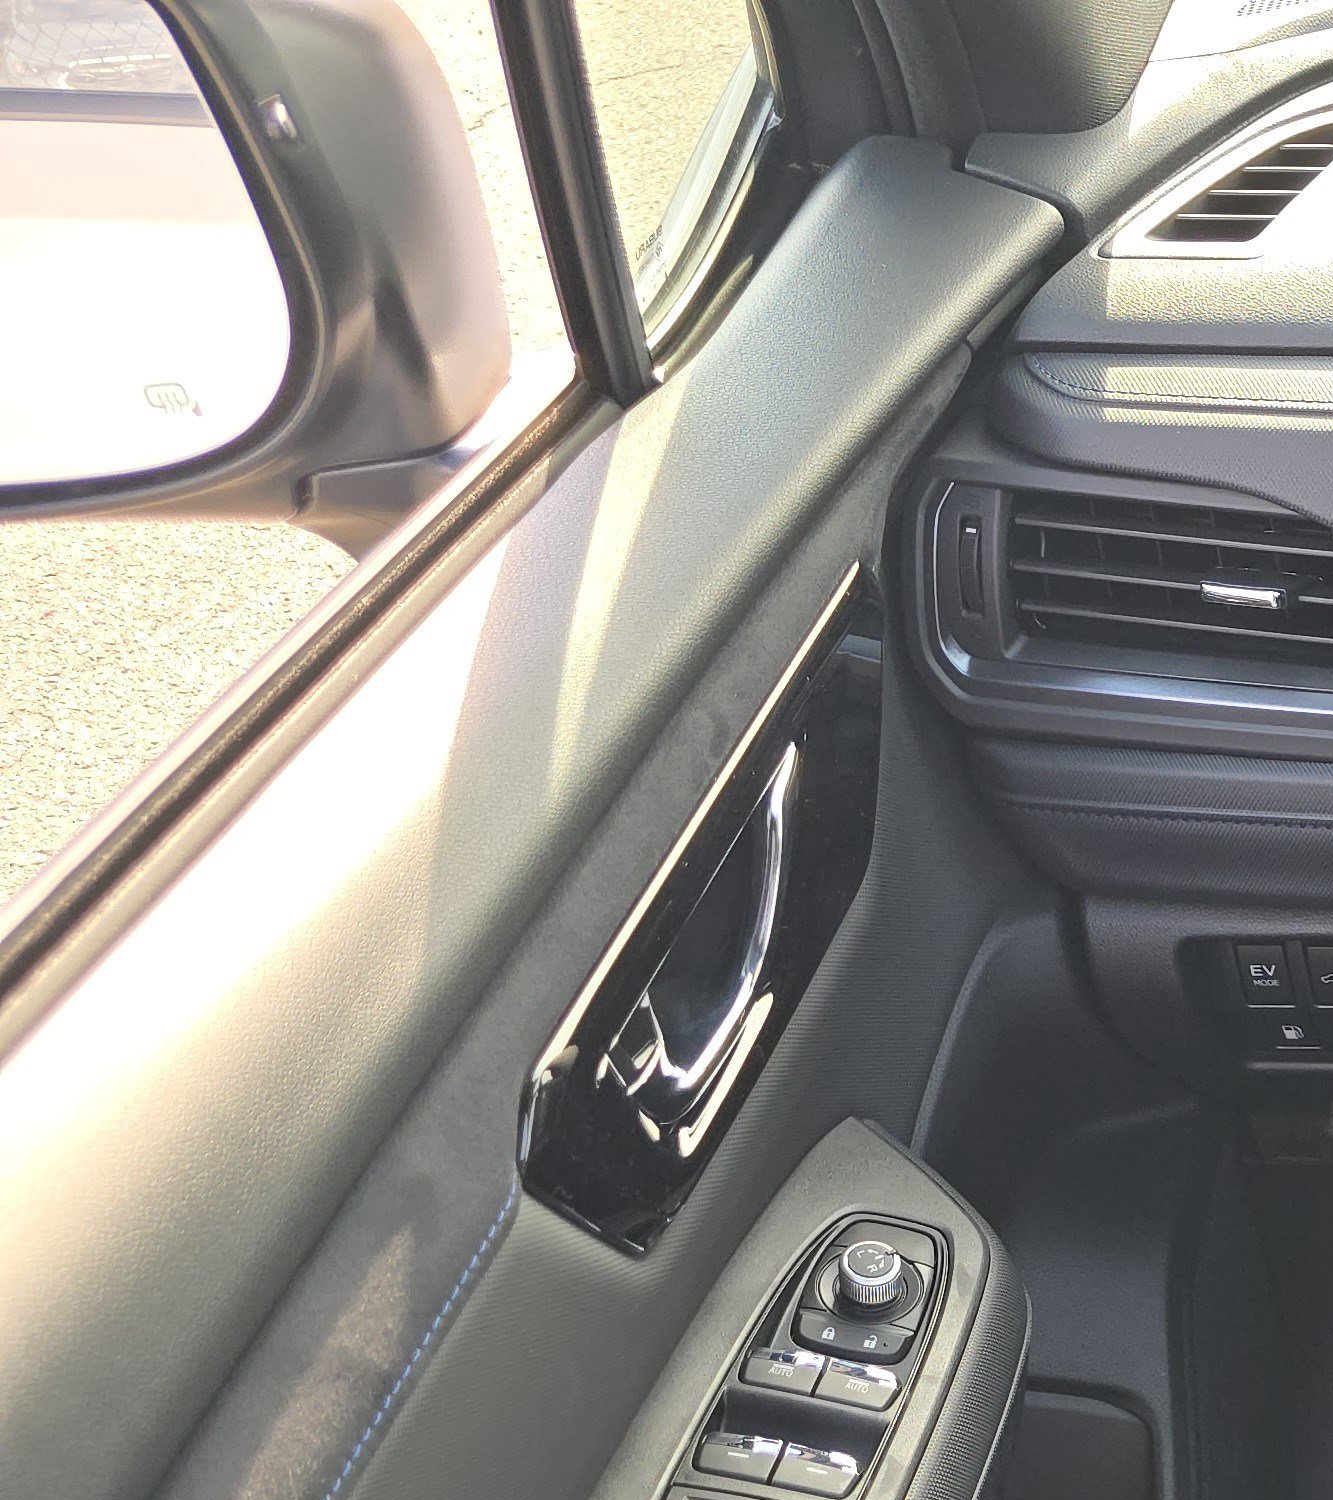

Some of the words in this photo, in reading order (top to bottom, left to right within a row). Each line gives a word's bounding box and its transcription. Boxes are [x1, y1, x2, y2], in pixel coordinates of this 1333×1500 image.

[1250, 964, 1276, 978] EV
[1252, 979, 1281, 988] MODE
[768, 1366, 794, 1378] AUTO
[845, 1382, 869, 1394] AUTO
